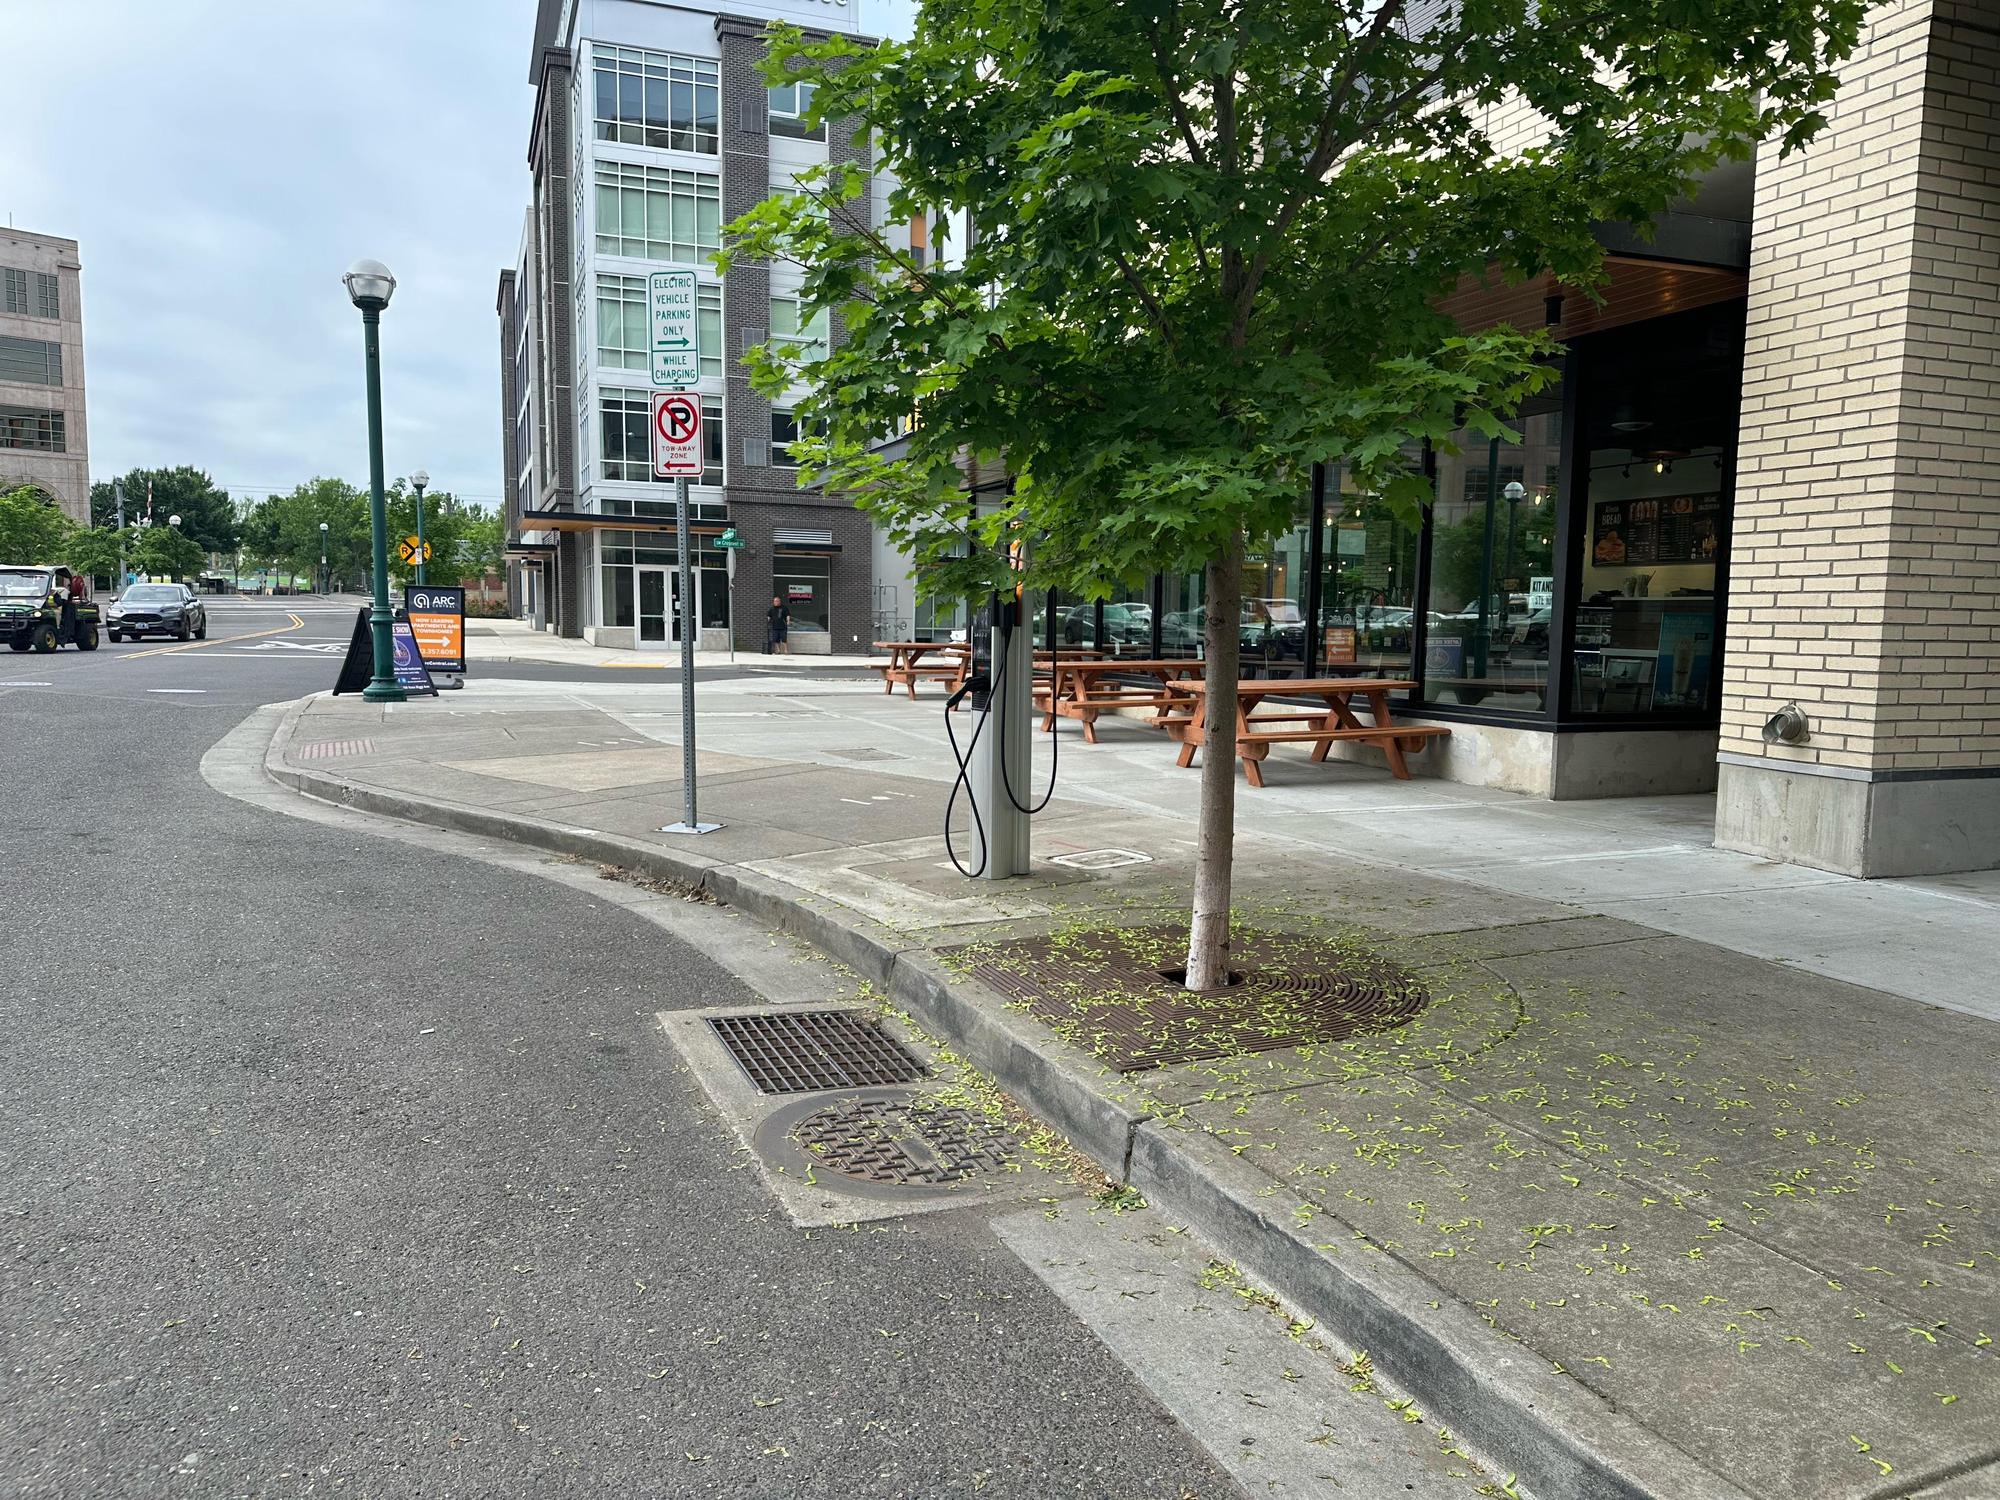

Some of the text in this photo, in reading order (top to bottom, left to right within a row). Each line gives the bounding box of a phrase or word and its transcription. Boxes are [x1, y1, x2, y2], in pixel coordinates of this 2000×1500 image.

[654, 278, 691, 289] ELECTRIC
[656, 294, 689, 304] VEHICLE
[656, 310, 691, 320] PARKING
[663, 326, 684, 336] ONLY
[663, 355, 687, 365] WHILE
[655, 369, 696, 380] CHARGING
[401, 546, 429, 555] R R
[432, 596, 455, 605] ARC
